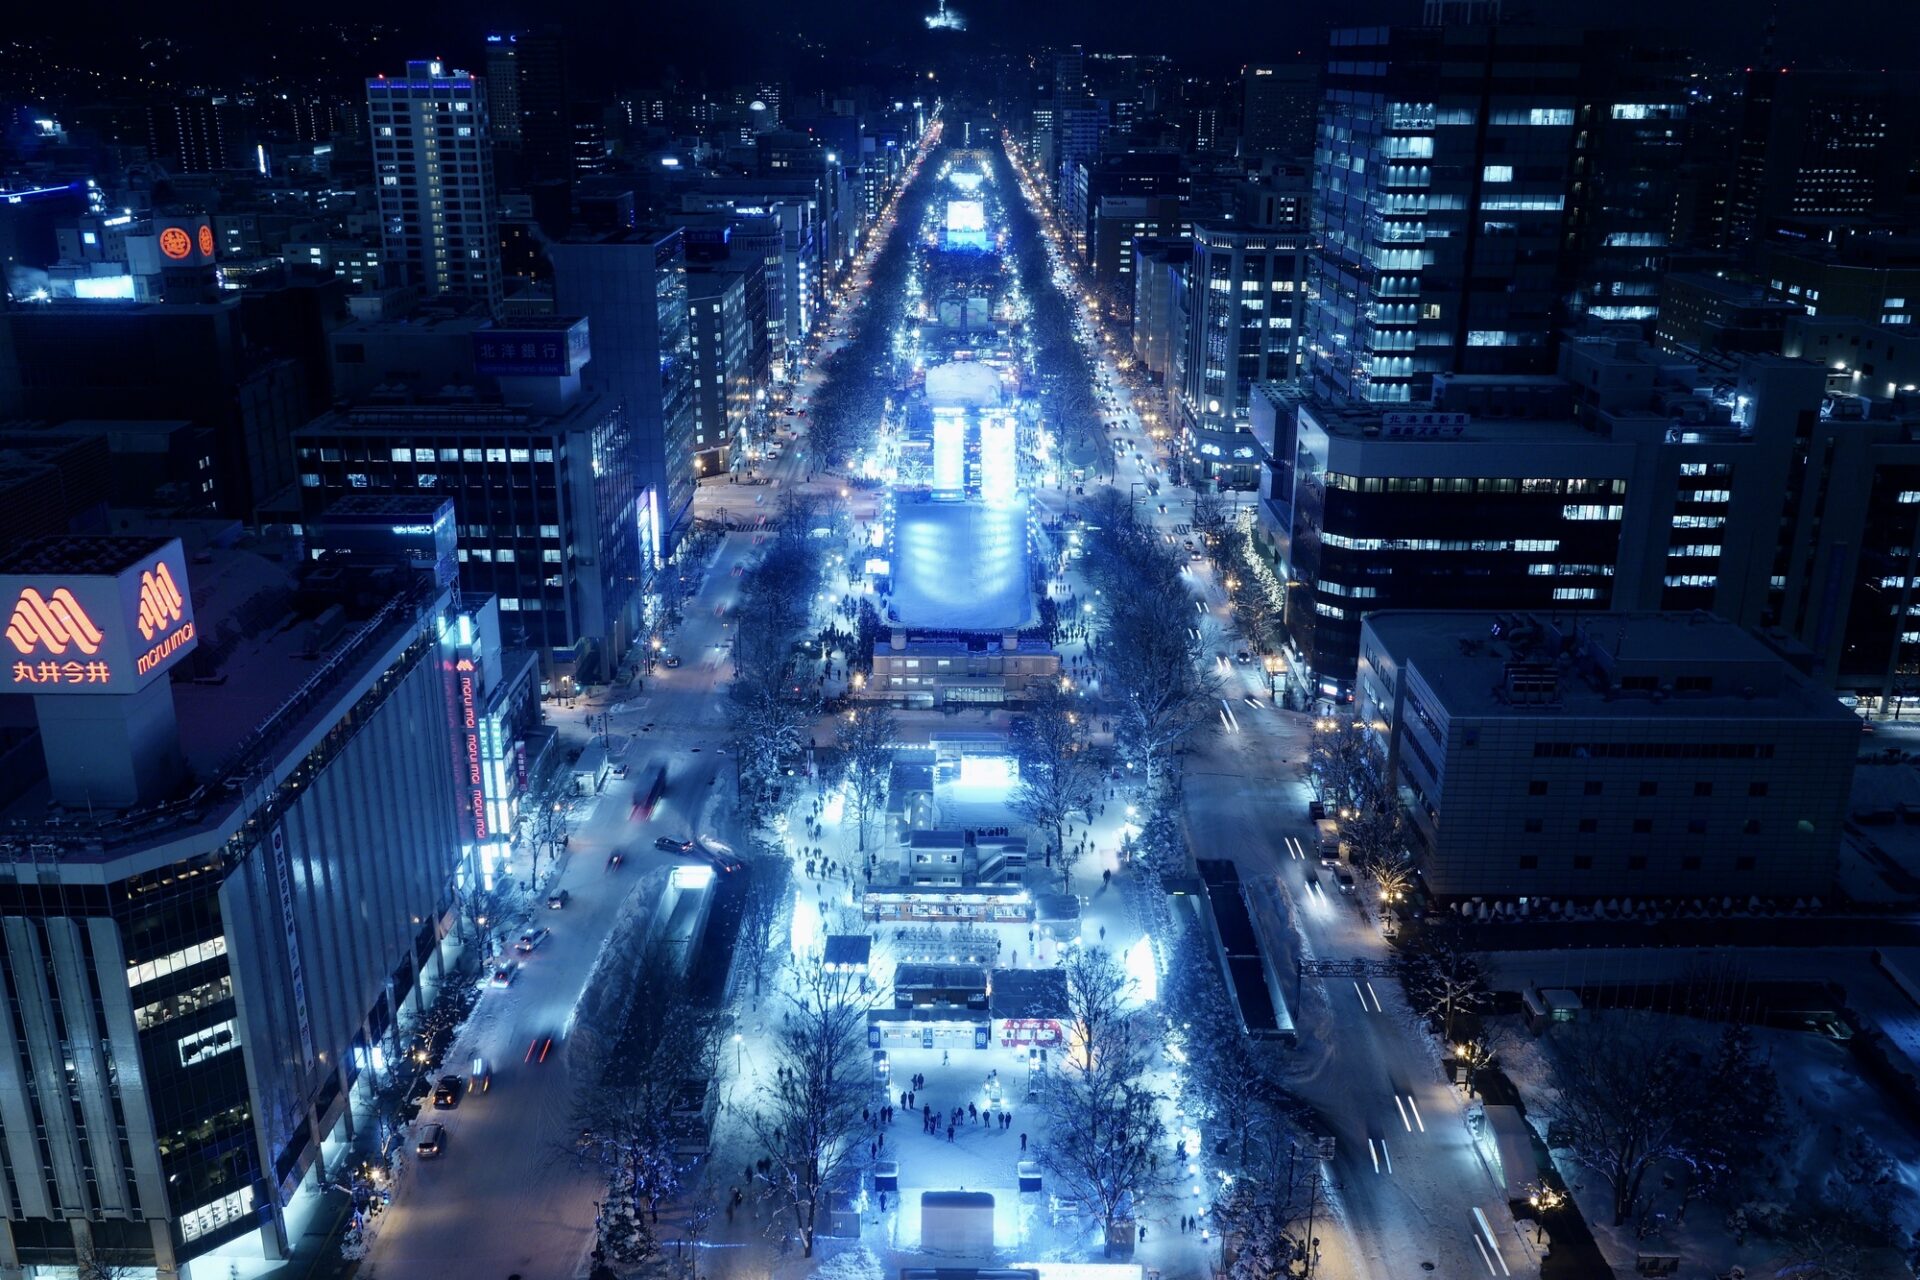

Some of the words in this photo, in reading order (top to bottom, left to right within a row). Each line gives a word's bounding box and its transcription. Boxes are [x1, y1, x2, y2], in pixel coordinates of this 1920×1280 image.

[480, 343, 557, 359] 北洋銀行
[13, 661, 110, 683] 丸井今井
